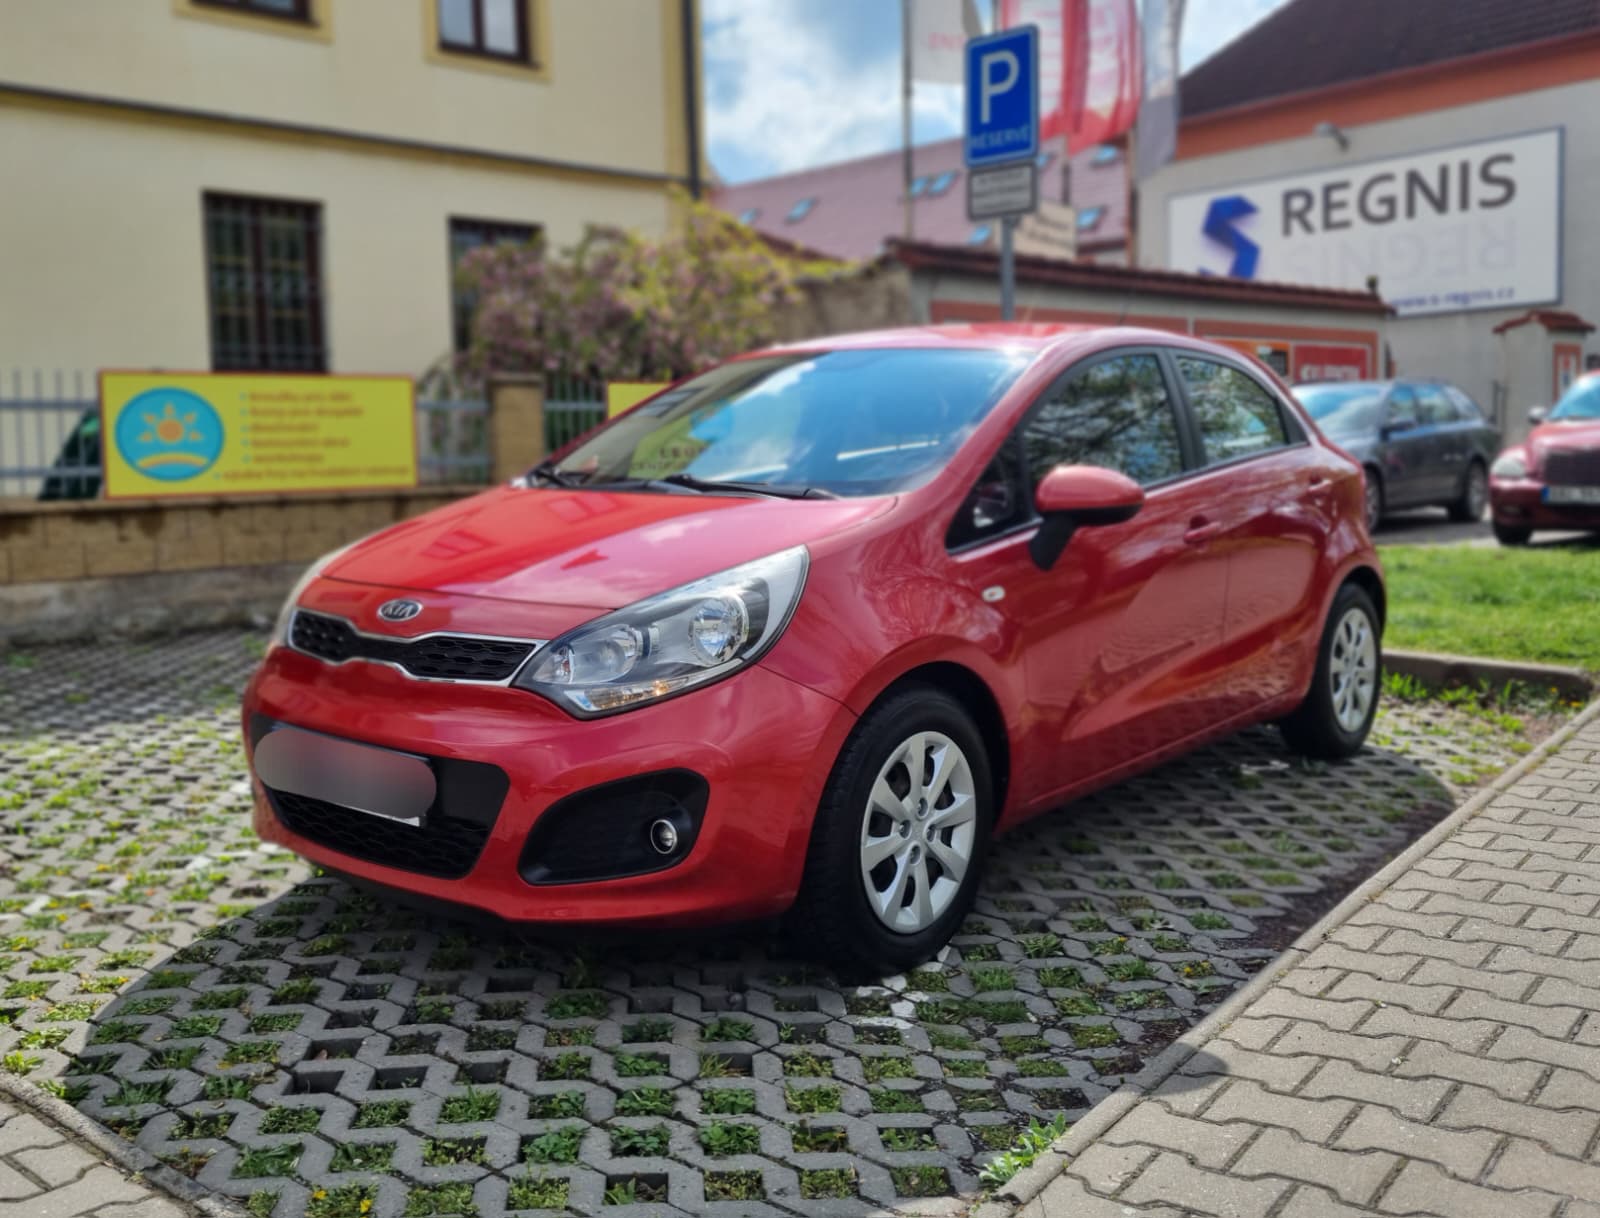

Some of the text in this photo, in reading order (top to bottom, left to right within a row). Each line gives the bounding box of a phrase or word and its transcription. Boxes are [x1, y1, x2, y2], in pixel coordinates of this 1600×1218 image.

[980, 50, 1019, 124] P
[1281, 153, 1517, 237] REGNIS
[383, 602, 413, 618] KIA
